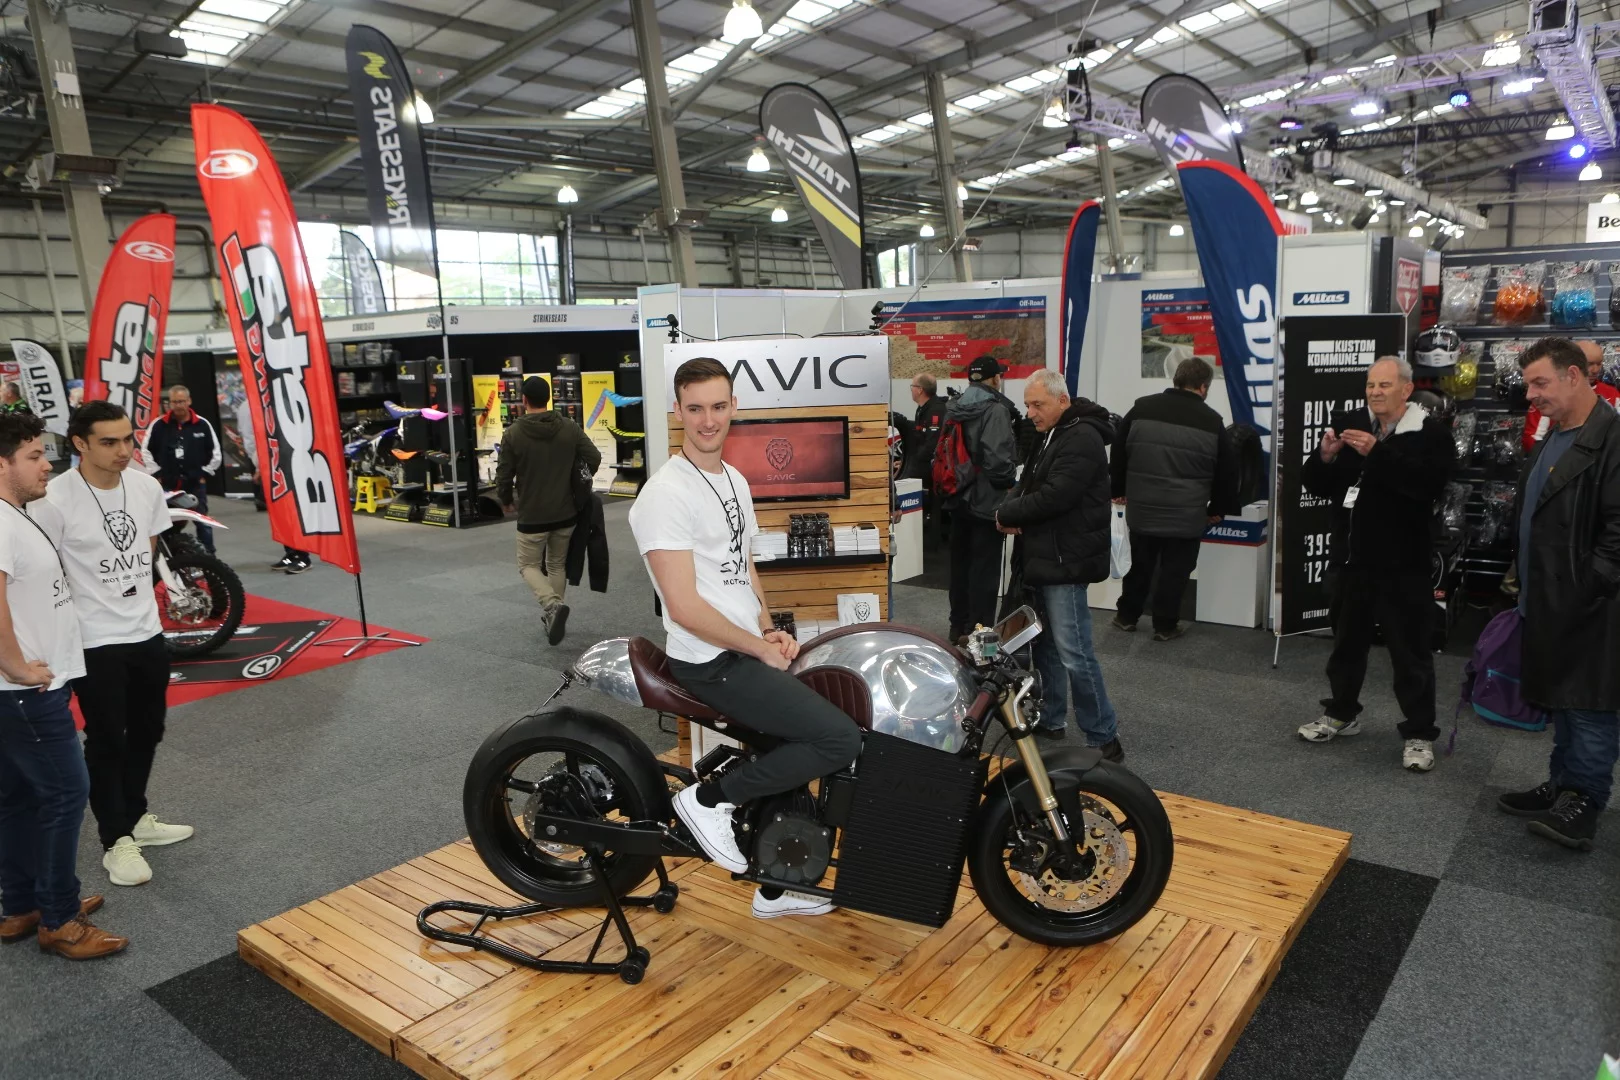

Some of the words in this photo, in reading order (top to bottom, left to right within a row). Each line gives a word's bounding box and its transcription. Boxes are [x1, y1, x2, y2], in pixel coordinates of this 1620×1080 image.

[1019, 299, 1044, 307] Off-Road
[1298, 293, 1344, 304] Mitas
[450, 316, 459, 325] 95
[533, 314, 567, 323] STRIKESEATS
[1335, 339, 1375, 353] KUSTOM
[101, 303, 146, 424] ta
[1307, 352, 1359, 367] KOMMUNE
[731, 355, 868, 392] AVIC
[1304, 400, 1336, 426] BUY
[766, 473, 796, 481] SAVIC
[900, 497, 920, 508] Mitas
[1207, 526, 1248, 537] Mitas
[100, 552, 150, 574] SAVIC
